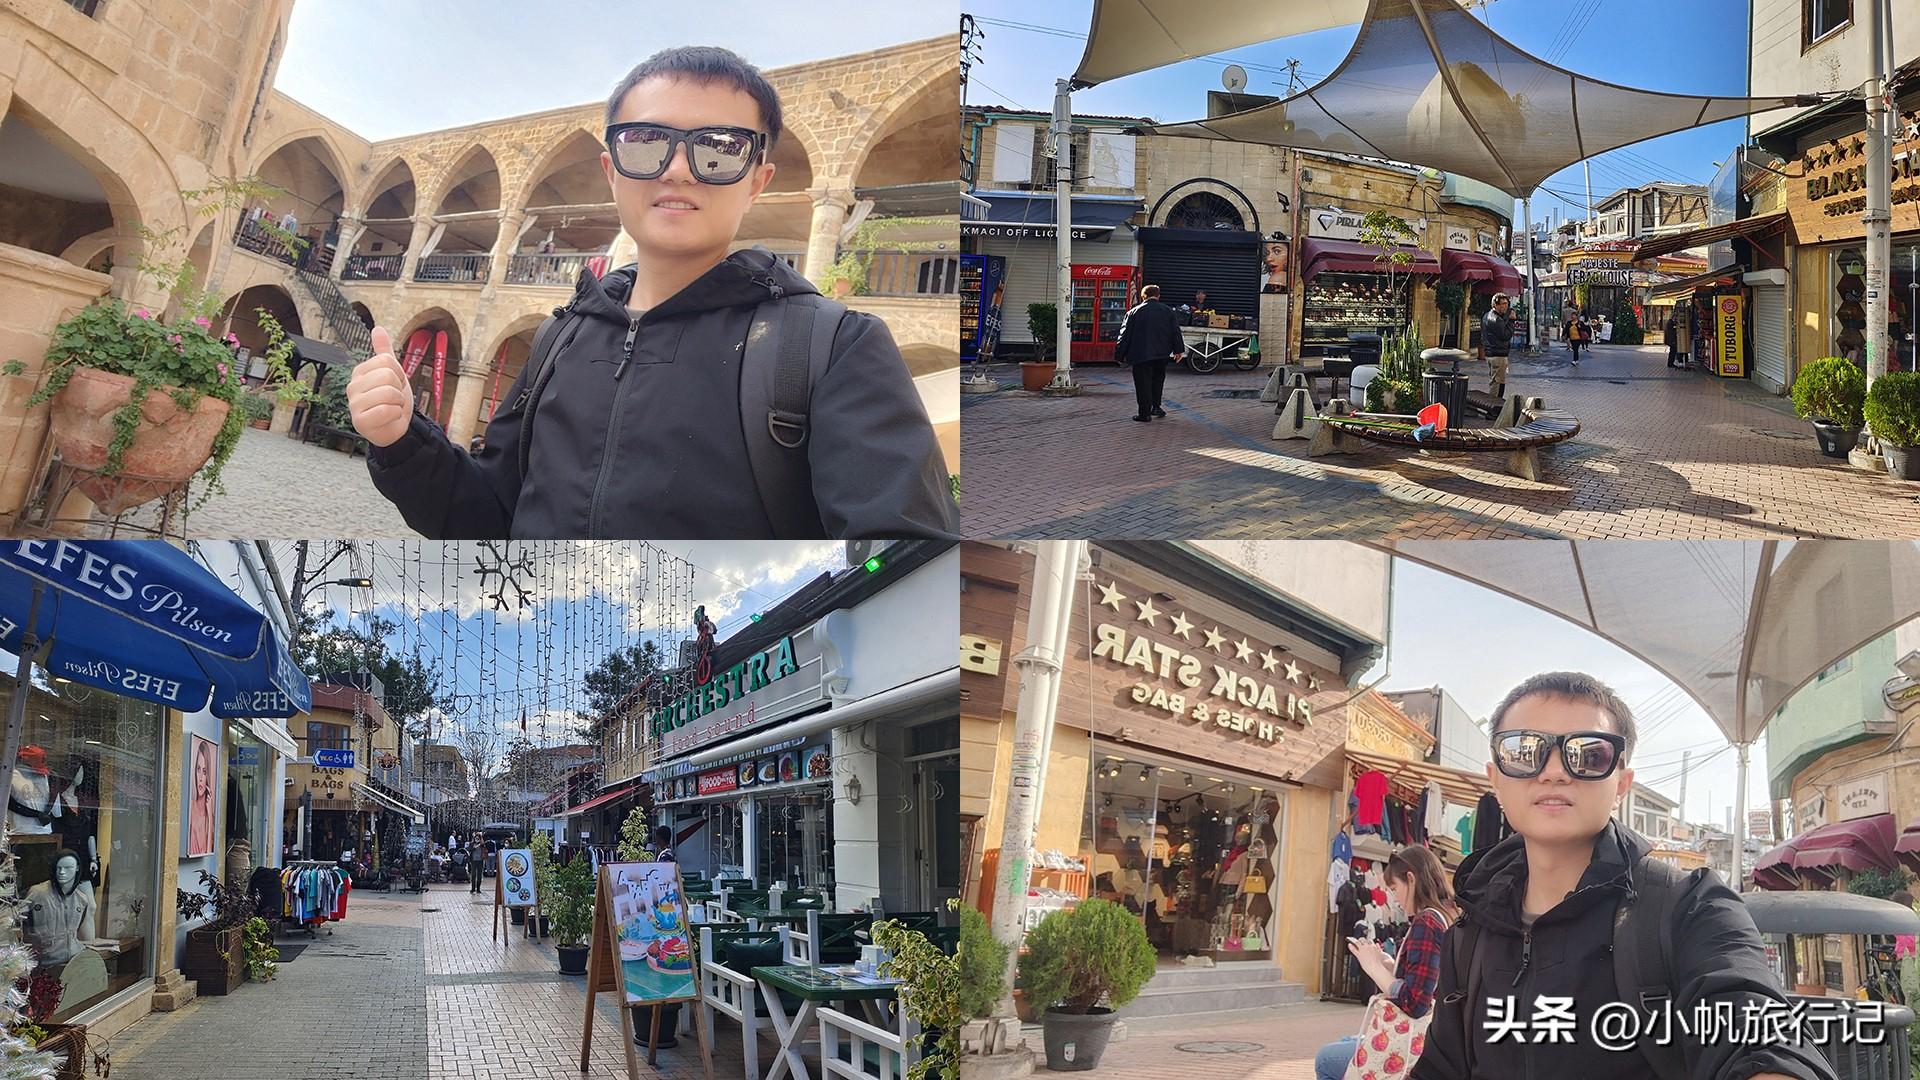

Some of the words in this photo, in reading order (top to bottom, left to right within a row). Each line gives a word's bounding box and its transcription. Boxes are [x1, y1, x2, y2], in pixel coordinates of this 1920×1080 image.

[960, 226, 1000, 236] KMACI
[1006, 228, 1029, 236] OFF
[1035, 230, 1087, 239] LICCE
[1580, 258, 1618, 268] MAJESTE
[985, 314, 1002, 331] EFES
[1724, 316, 1736, 361] TUBORG
[14, 540, 139, 602] EFES
[139, 584, 233, 644] Pilsen
[706, 701, 757, 739] sound
[312, 766, 345, 775] BAGS
[311, 780, 344, 789] BAGS
